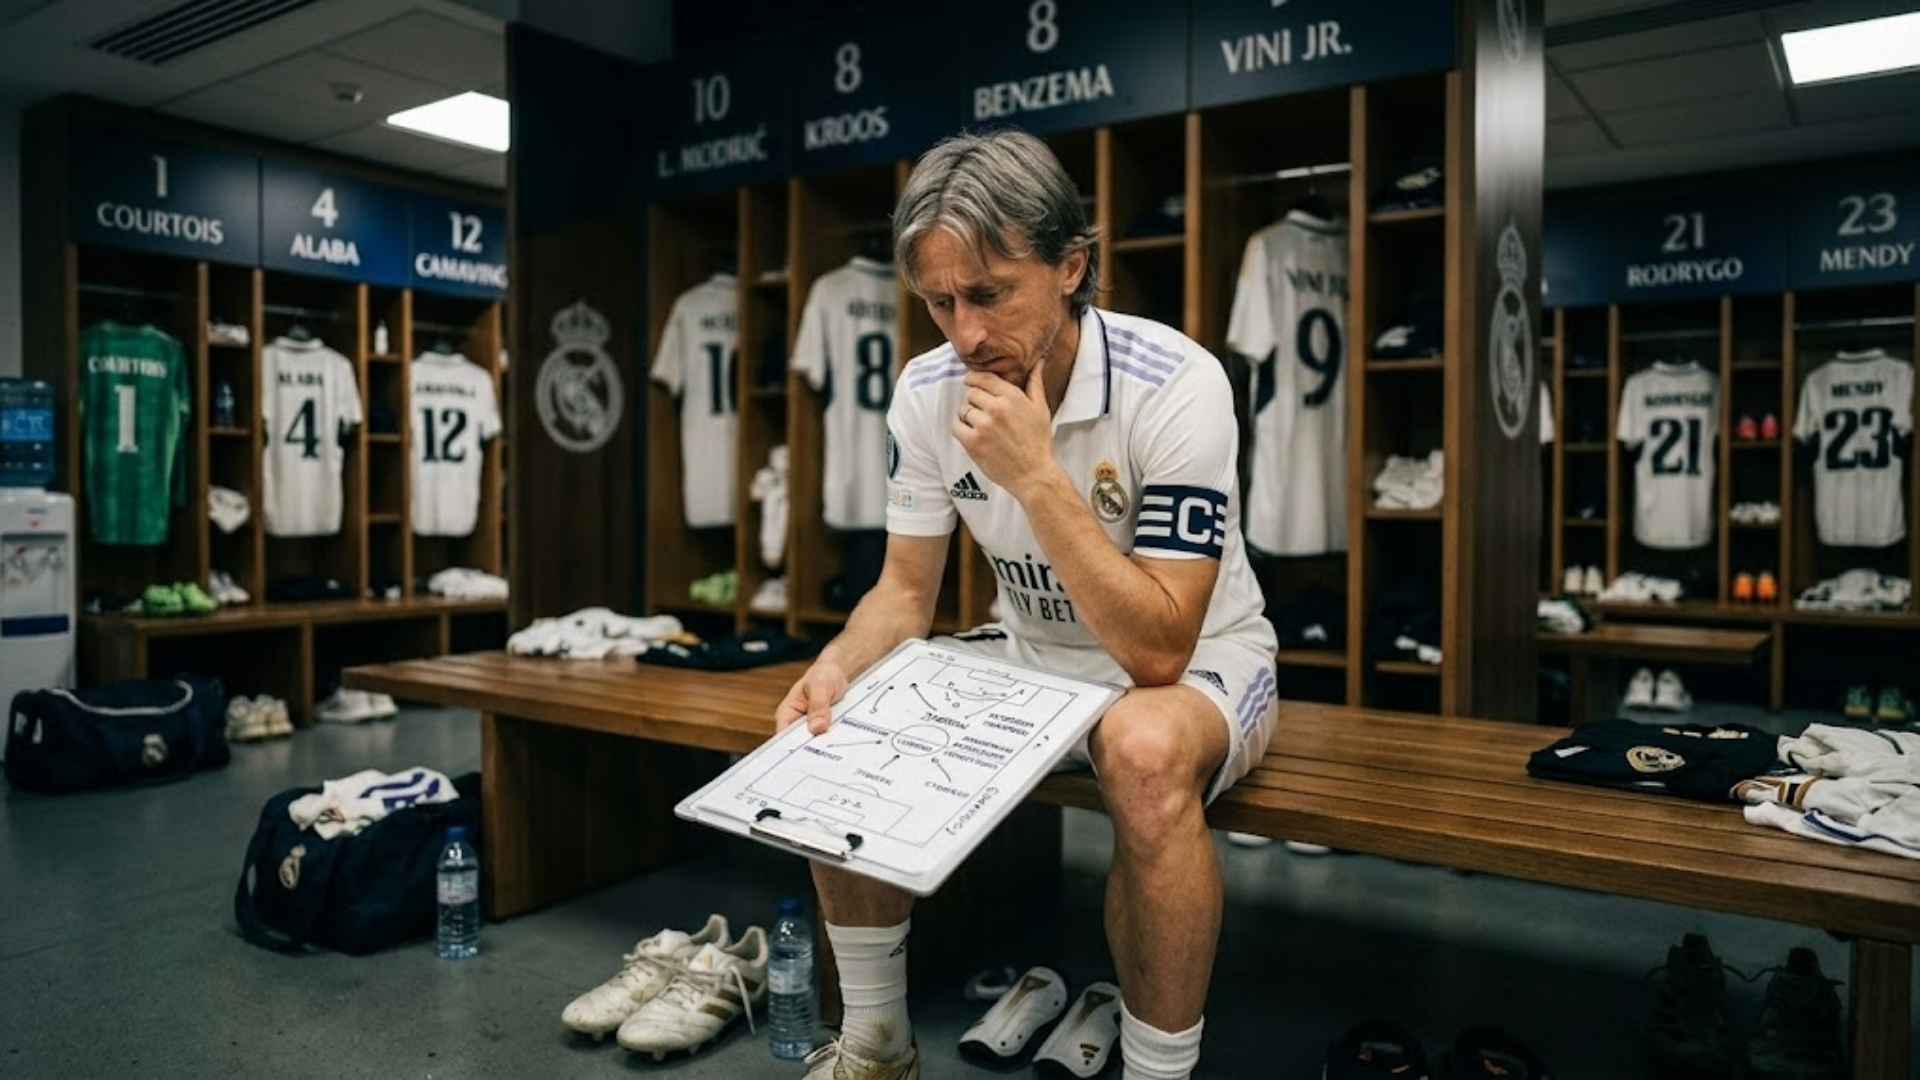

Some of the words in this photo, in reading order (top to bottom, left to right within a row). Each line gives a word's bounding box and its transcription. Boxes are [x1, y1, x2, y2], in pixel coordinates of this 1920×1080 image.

[1026, 0, 1061, 52] 8
[1220, 29, 1292, 74] VINI
[1301, 21, 1353, 62] JR.
[833, 43, 863, 94] 8
[973, 64, 1115, 120] BENZEMA
[691, 74, 731, 125] 10
[804, 105, 891, 150] KROOS
[152, 154, 168, 198] 1
[97, 203, 224, 245] COURTOIS
[311, 187, 340, 229] 4
[448, 211, 483, 254] 12
[1661, 211, 1706, 253] 21
[1836, 192, 1898, 237] 23
[289, 233, 361, 267] ALABA
[1626, 256, 1744, 289] RODRYGO
[1819, 242, 1916, 273] MENDY
[856, 331, 893, 413] 8
[1296, 308, 1343, 409] 9
[113, 384, 139, 454] 1
[284, 398, 319, 460] 4
[420, 406, 468, 464] 12
[1824, 406, 1894, 472] 23
[1650, 416, 1703, 478] 21
[1177, 497, 1214, 545] C
